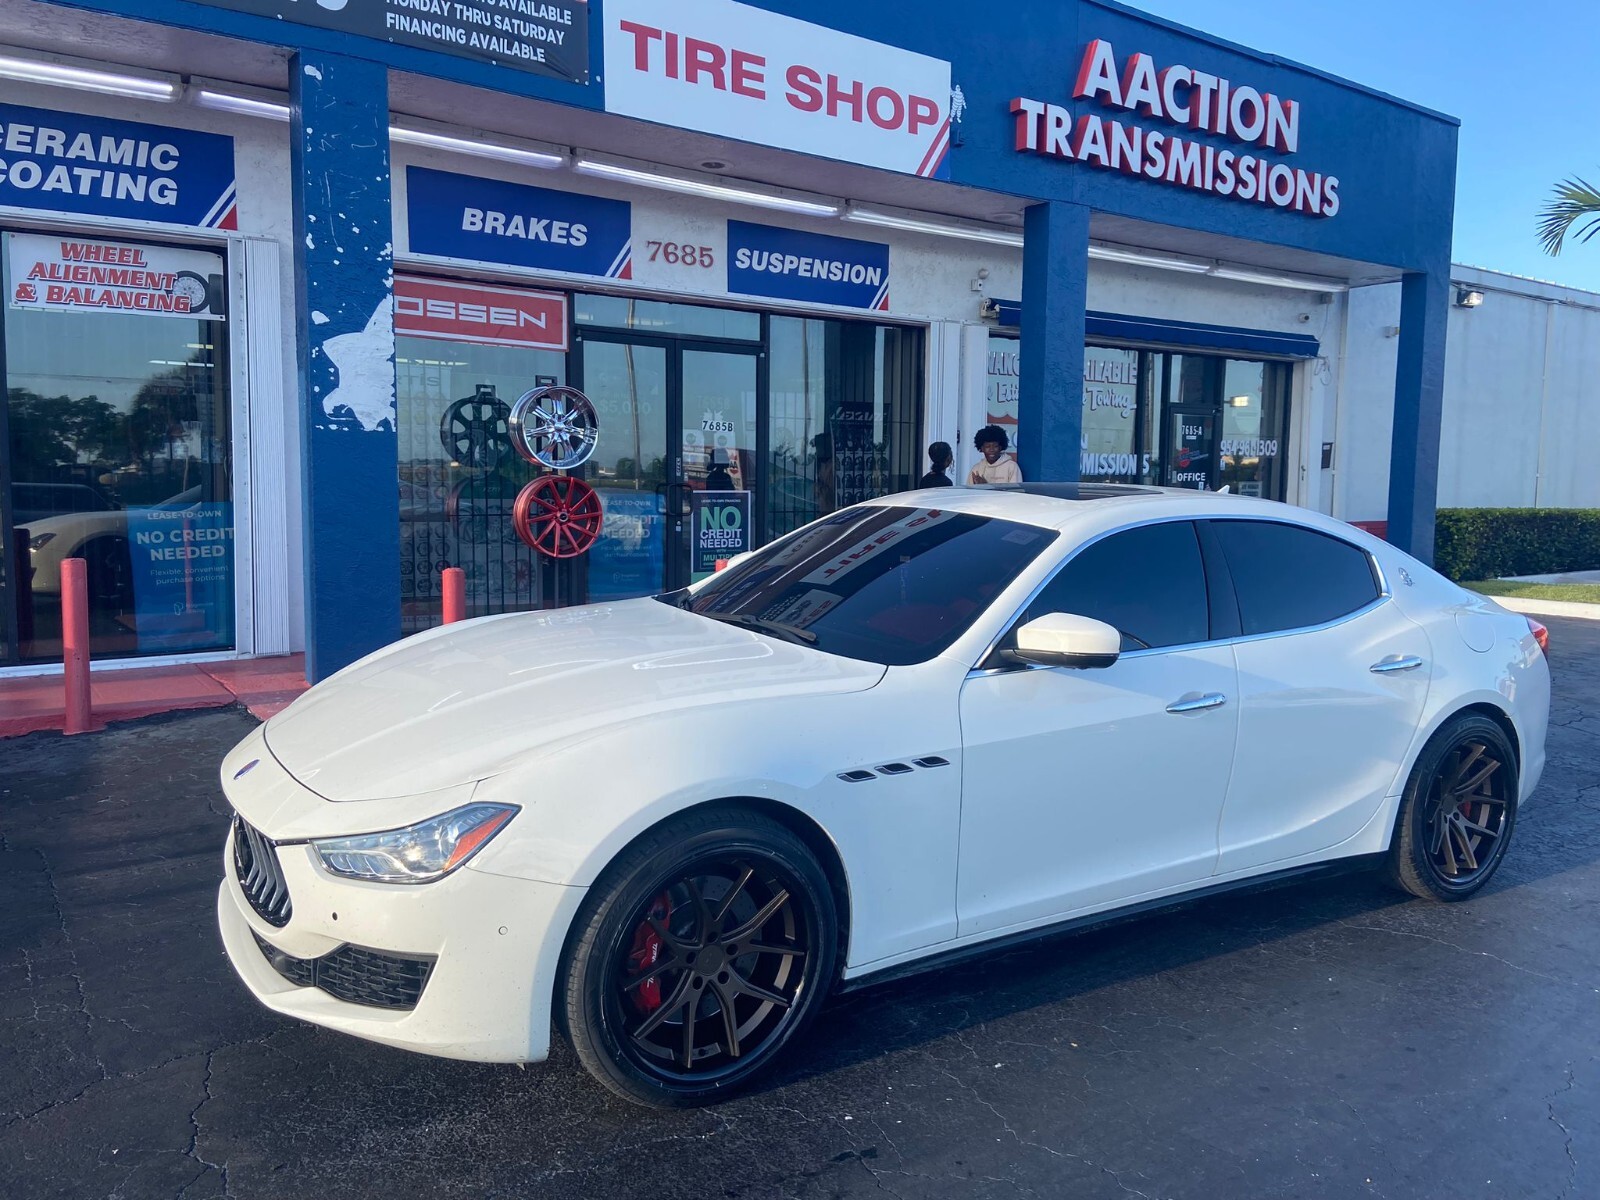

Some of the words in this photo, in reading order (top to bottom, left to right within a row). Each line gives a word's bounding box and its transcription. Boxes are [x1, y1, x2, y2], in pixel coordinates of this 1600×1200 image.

[387, 0, 451, 17] ONDAY
[454, 4, 491, 27] THRU
[494, 15, 566, 46] SATURDAY
[386, 13, 467, 44] FINANCING
[469, 31, 546, 63] AVAILABLE
[620, 19, 766, 101] TIRE
[785, 64, 940, 136] SHOP
[1073, 38, 1300, 154] AACTION
[0, 122, 180, 172] ERAMIC
[1010, 97, 1340, 217] TRANSMISSIONS
[461, 206, 589, 247] BRAKES
[60, 241, 147, 267] WHEEL
[645, 239, 715, 268] 7685
[735, 247, 883, 287] SUSPENSION
[27, 261, 177, 290] ALIGNMENT
[15, 282, 38, 303] &
[46, 283, 191, 313] BALANCING
[394, 295, 547, 329] OSSEN
[1086, 387, 1137, 419] Towing
[702, 420, 733, 432] 7685B
[1177, 472, 1206, 482] OFFICE
[147, 510, 222, 520] LEASE-TO-OWN
[614, 514, 659, 525] CREDIT
[700, 506, 742, 530] NO
[137, 531, 165, 545] NO
[170, 528, 234, 542] CREDIT
[602, 528, 650, 539] NEEDED
[700, 528, 742, 539] CREDIT
[700, 538, 742, 549] NEEDED
[151, 545, 225, 561] NEEDED
[195, 574, 226, 584] options
